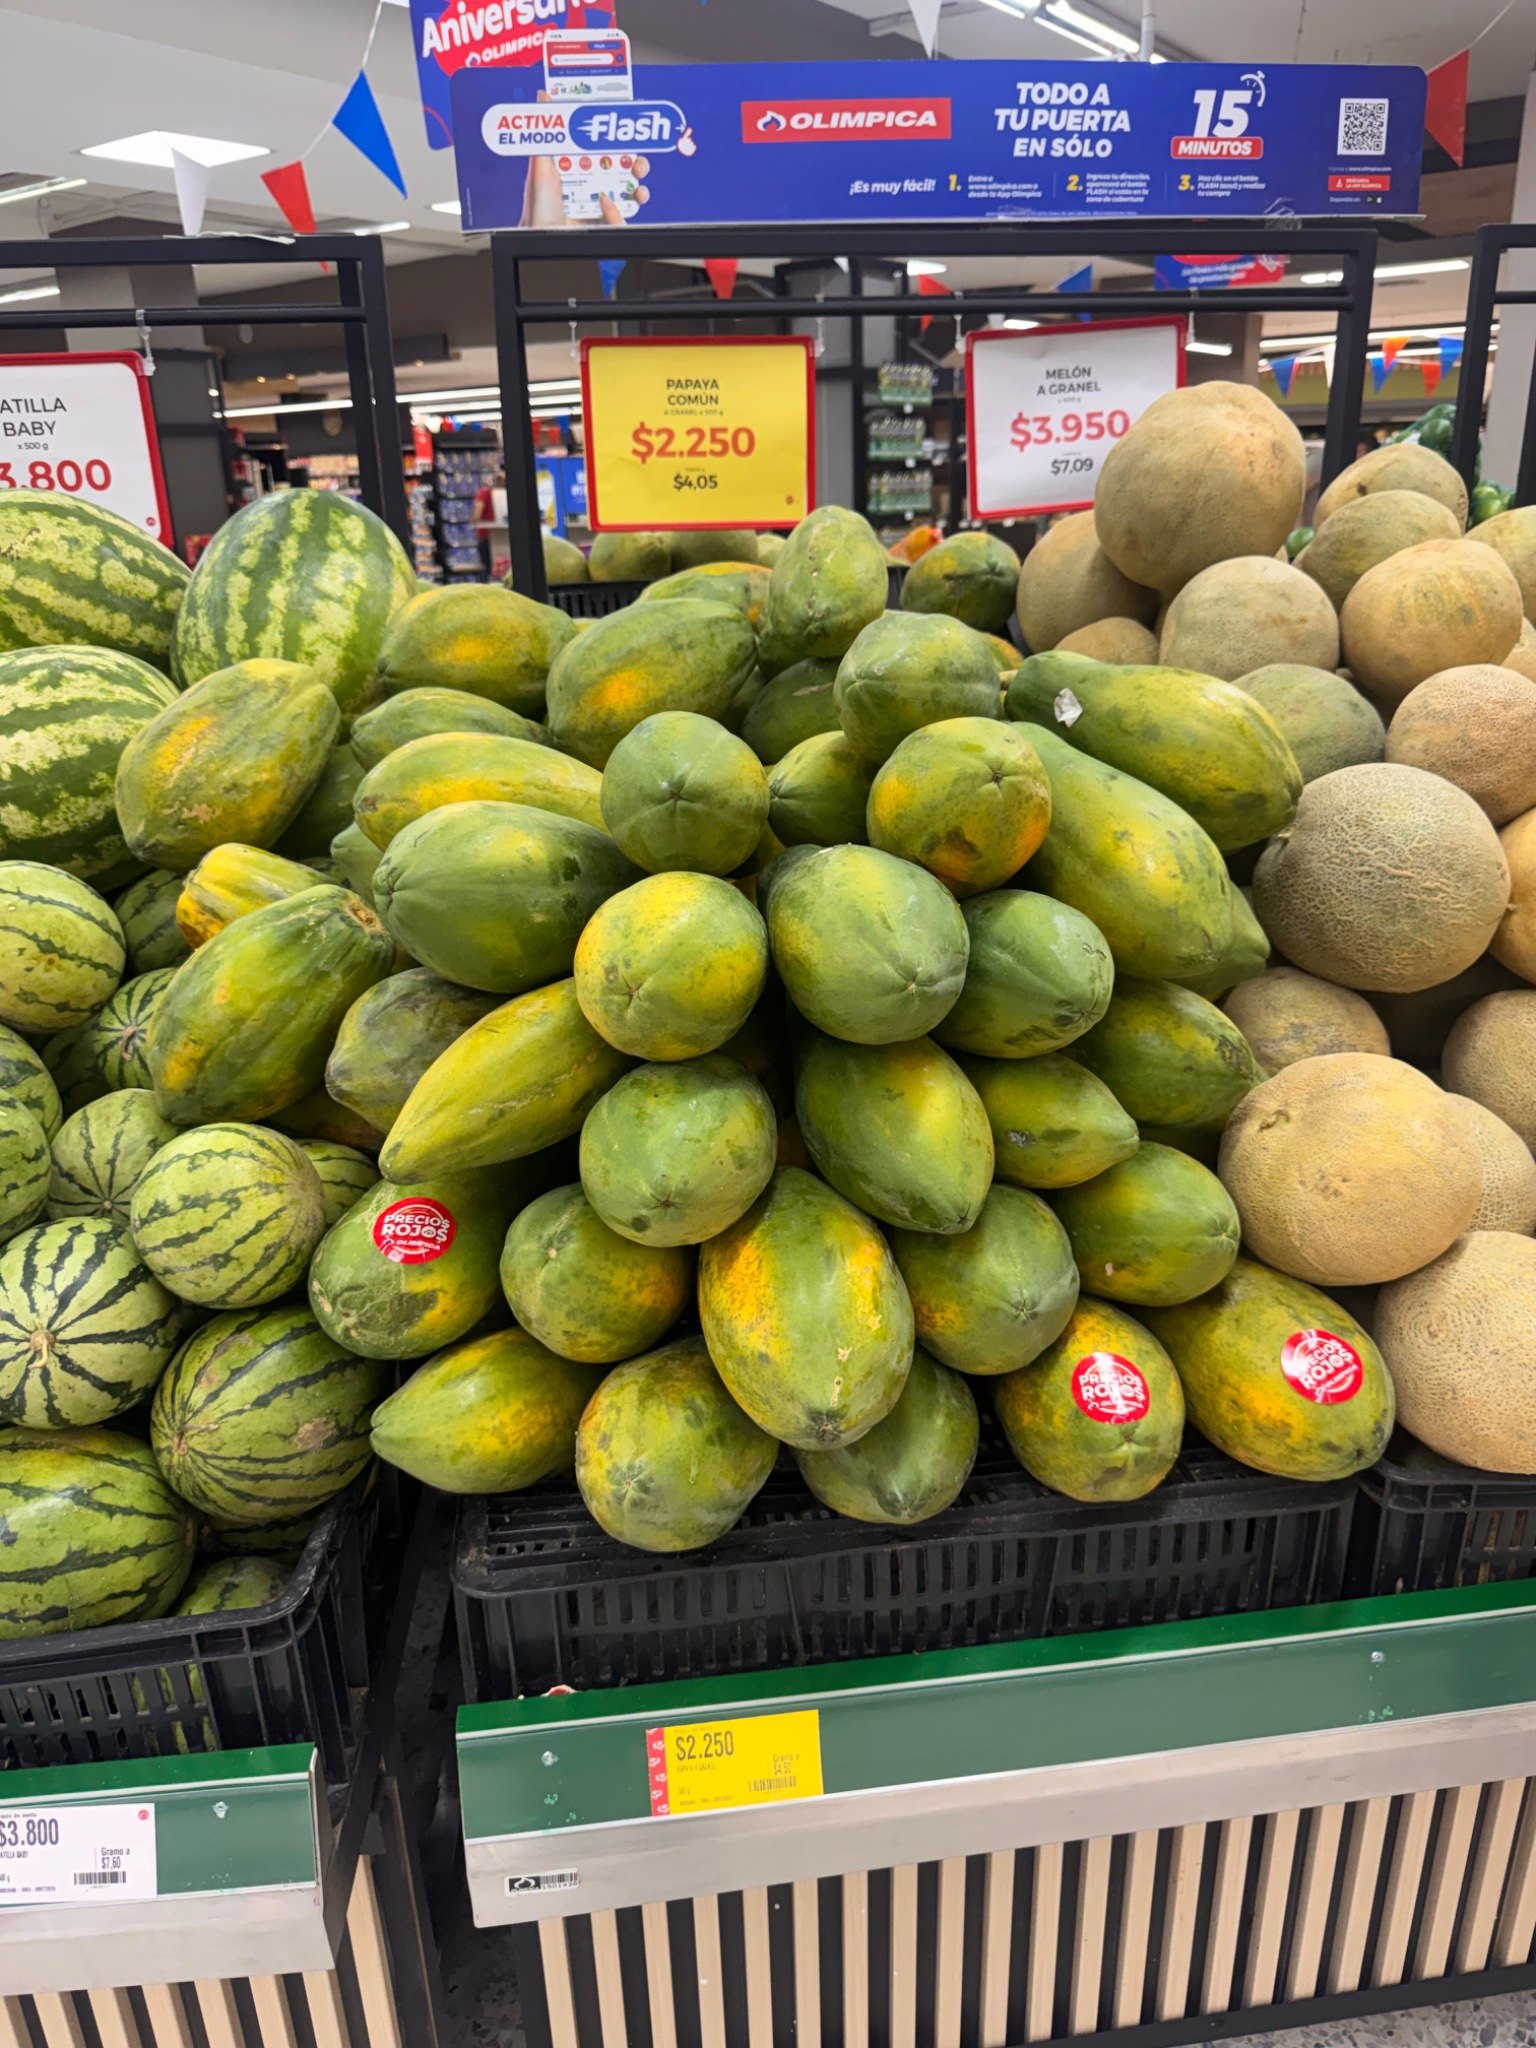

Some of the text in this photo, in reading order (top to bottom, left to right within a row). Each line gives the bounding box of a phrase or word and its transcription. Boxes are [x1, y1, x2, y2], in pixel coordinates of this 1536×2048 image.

[423, 0, 598, 58] Aniversa
[482, 31, 546, 63] OLIMPIC
[1016, 82, 1110, 105] TODO A
[497, 114, 565, 130] ACTIVA
[790, 110, 938, 130] OLIMPICA
[994, 108, 1131, 132] TU PUERTA
[1193, 89, 1253, 138] 15
[580, 111, 671, 142] Flash
[499, 131, 566, 145] EL MODO
[1013, 133, 1113, 158] EN SÓLO
[1178, 140, 1253, 155] MINUTOS
[871, 181, 901, 195] muy
[902, 177, 936, 193] fácil!
[949, 174, 962, 192] 1.
[1066, 174, 1083, 191] 2.
[1178, 174, 1195, 191] 3.
[1045, 365, 1091, 380] MELÓN
[666, 379, 719, 390] PAPAYA
[1037, 381, 1101, 396] A GRANEL
[0, 397, 67, 414] ATILLA
[667, 391, 719, 406] COMÚN
[3, 421, 56, 437] BABY
[1010, 410, 1130, 453] $3.950
[24, 442, 41, 450] 500
[42, 443, 49, 451] g
[631, 421, 756, 465] $2.250
[1050, 458, 1093, 475] $7,09
[673, 473, 718, 492] $4,05
[384, 1214, 450, 1230] PRECIOS
[381, 1224, 449, 1242] ROJOS
[1299, 1348, 1354, 1390] ROJOS
[1079, 1374, 1143, 1388] PRIOS
[676, 1730, 734, 1761] $2.250
[0, 1818, 59, 1849] $3.800
[101, 1847, 130, 1856] Gramo a
